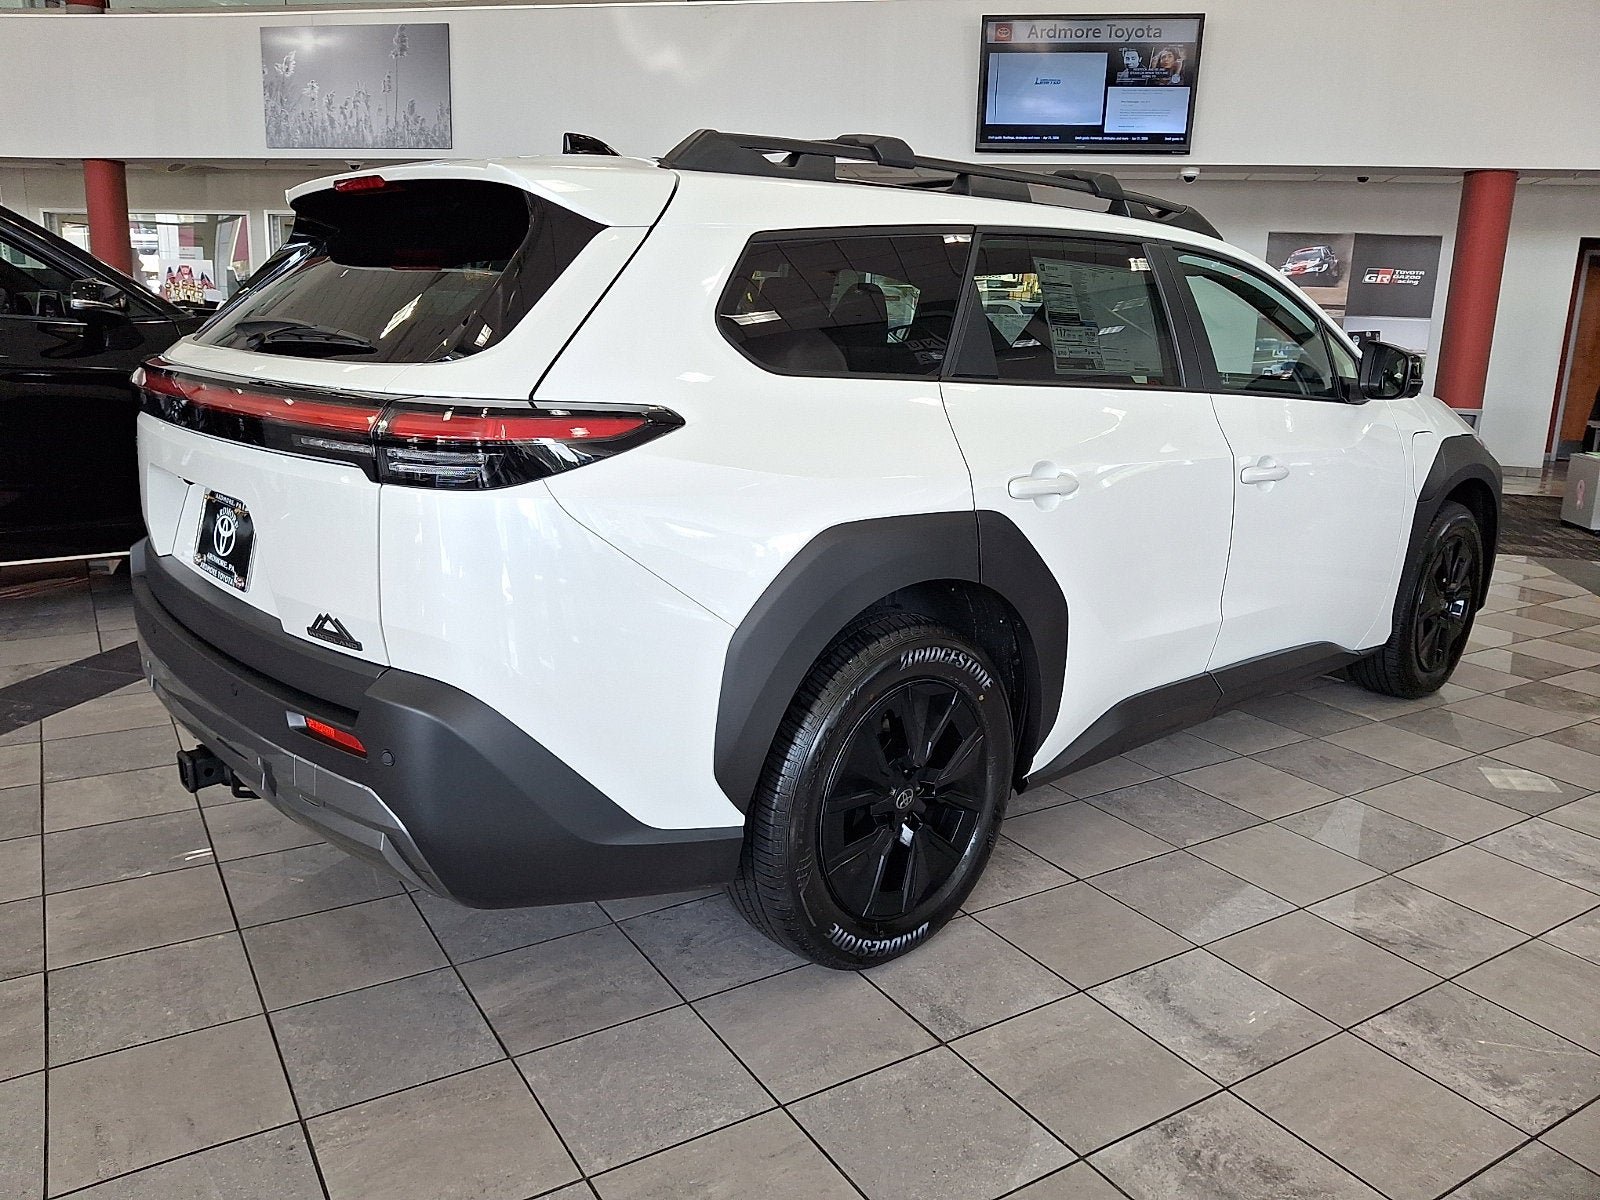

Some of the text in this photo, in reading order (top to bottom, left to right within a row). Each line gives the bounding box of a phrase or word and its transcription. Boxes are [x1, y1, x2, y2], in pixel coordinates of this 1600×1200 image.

[1027, 24, 1163, 42] Ardmore Toyota
[1365, 273, 1391, 283] GR
[217, 570, 235, 588] TOYOTA
[899, 646, 995, 692] BRIDGESTONE
